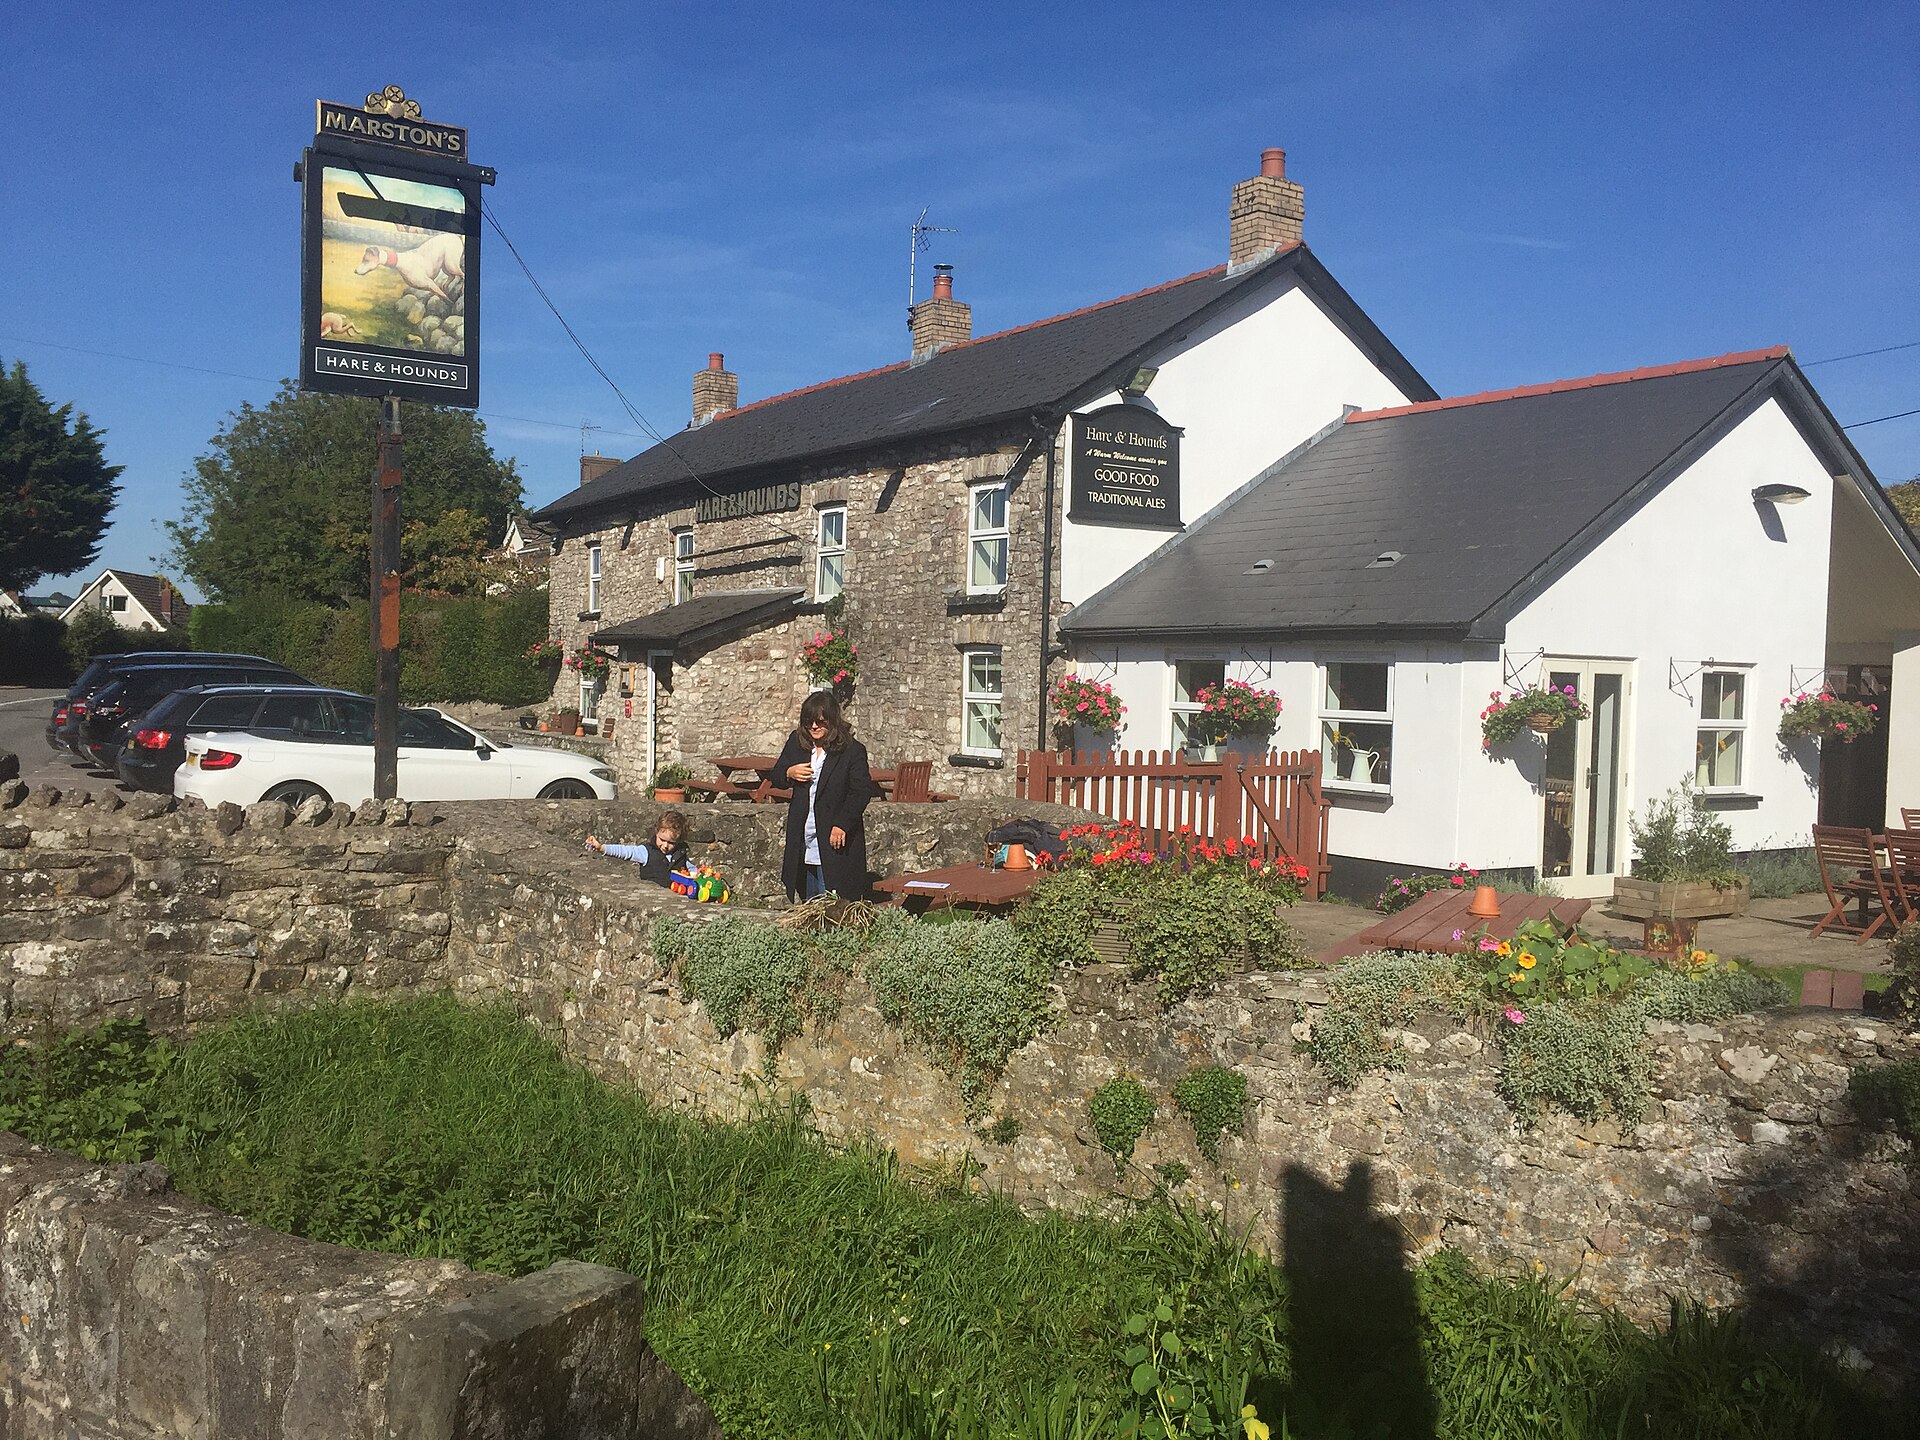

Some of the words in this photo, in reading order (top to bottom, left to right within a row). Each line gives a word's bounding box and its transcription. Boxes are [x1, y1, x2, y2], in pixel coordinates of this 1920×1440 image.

[325, 110, 461, 151] MARSTON'S
[326, 356, 370, 371] HARE
[373, 361, 386, 373] &
[390, 363, 458, 381] HOUNDS
[1086, 426, 1113, 443] Hare
[1114, 431, 1127, 444] &
[1128, 432, 1168, 450] Hounds
[1085, 448, 1093, 456] A
[1112, 451, 1137, 462] Welcome
[1094, 468, 1128, 483] GOOD
[1129, 472, 1160, 487] FOOD
[1087, 491, 1144, 507] TRADITIONAL
[1145, 497, 1166, 509] ALES
